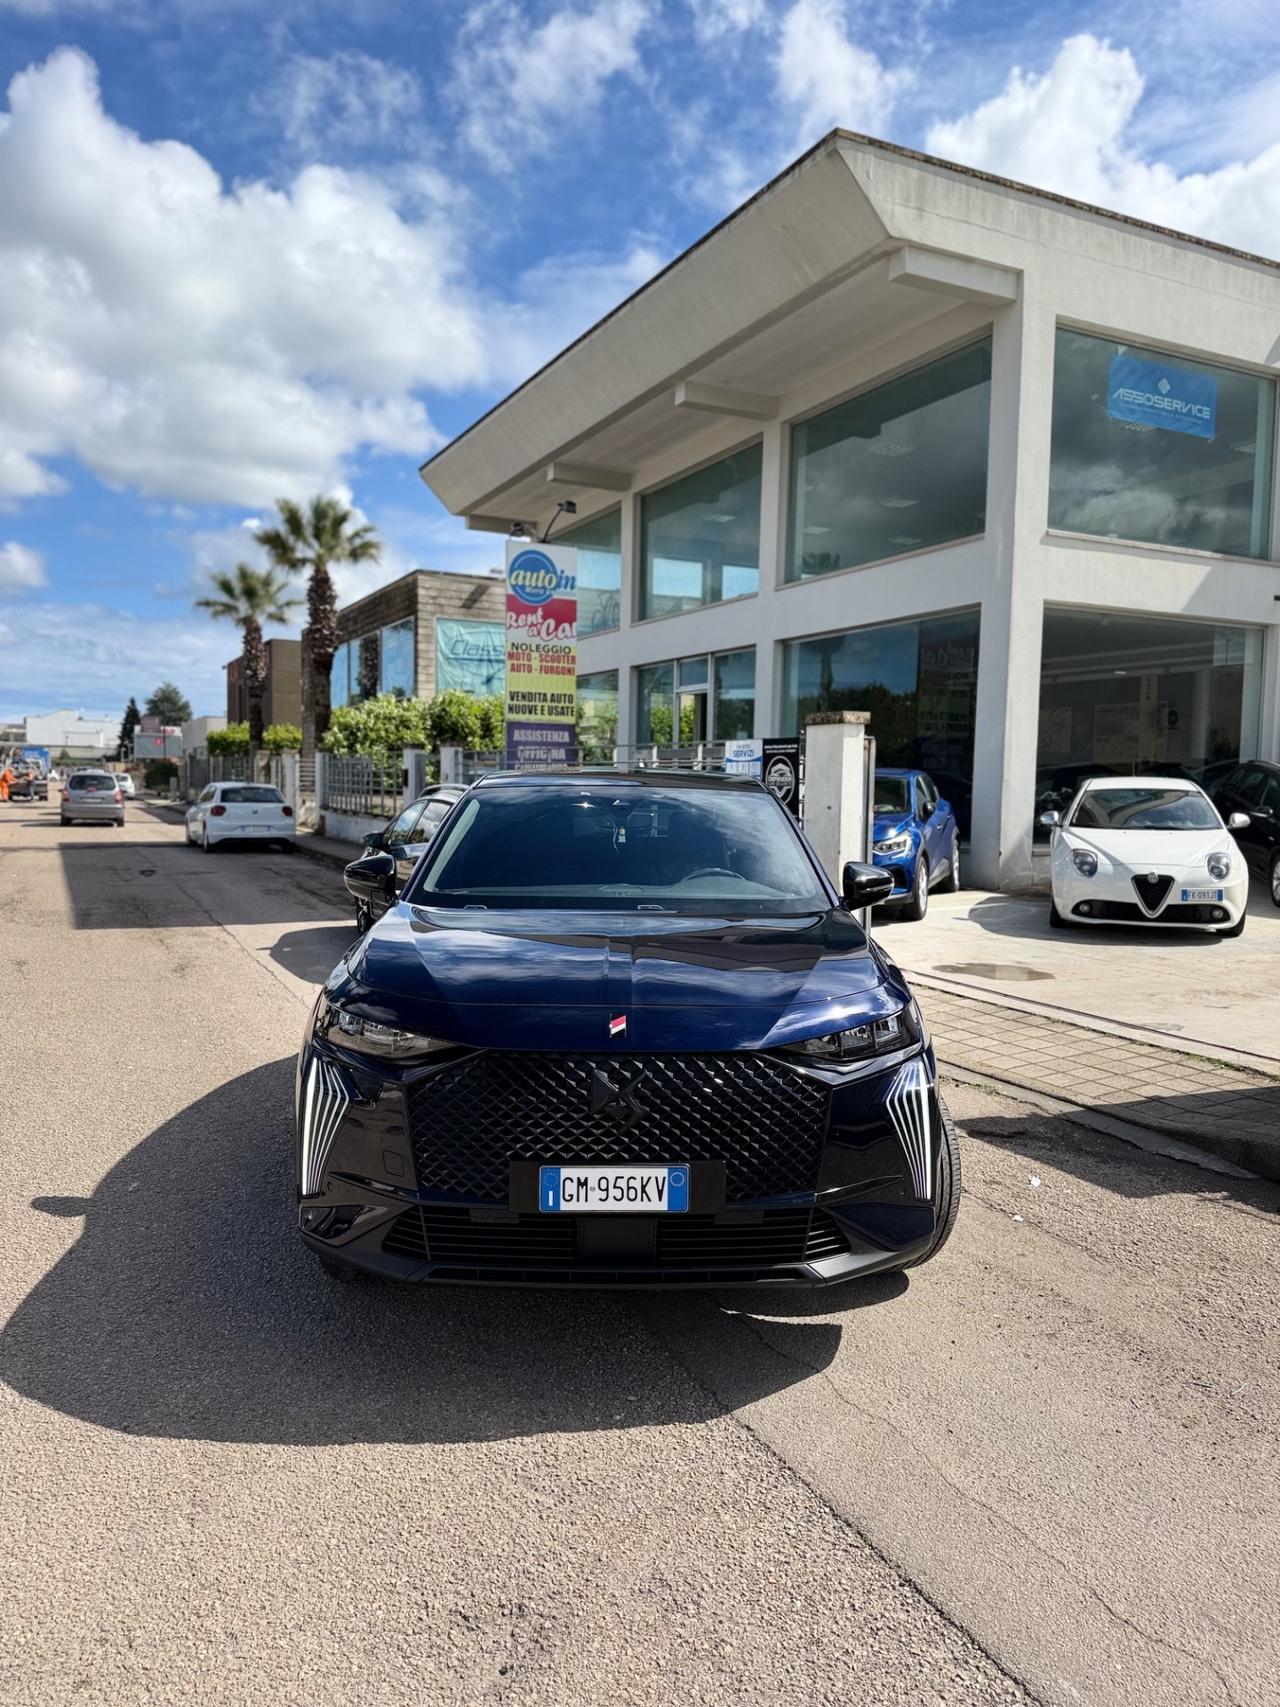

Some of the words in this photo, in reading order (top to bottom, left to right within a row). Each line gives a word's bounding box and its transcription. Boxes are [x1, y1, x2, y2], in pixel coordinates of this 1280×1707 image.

[1112, 387, 1211, 420] ASSOSERVICE
[506, 607, 544, 629] Rent
[511, 643, 572, 654] NOLEGGIO
[508, 651, 532, 663] MOTO
[539, 653, 577, 666] SCOOTER
[510, 663, 533, 674] AUTO
[539, 665, 576, 677] FURGONI
[509, 690, 548, 704] VENDITA
[550, 692, 574, 705] AUTO
[508, 704, 538, 716] NUOVE
[541, 706, 546, 716] E
[548, 706, 576, 718] USATE
[513, 730, 570, 742] ASSISTENZA
